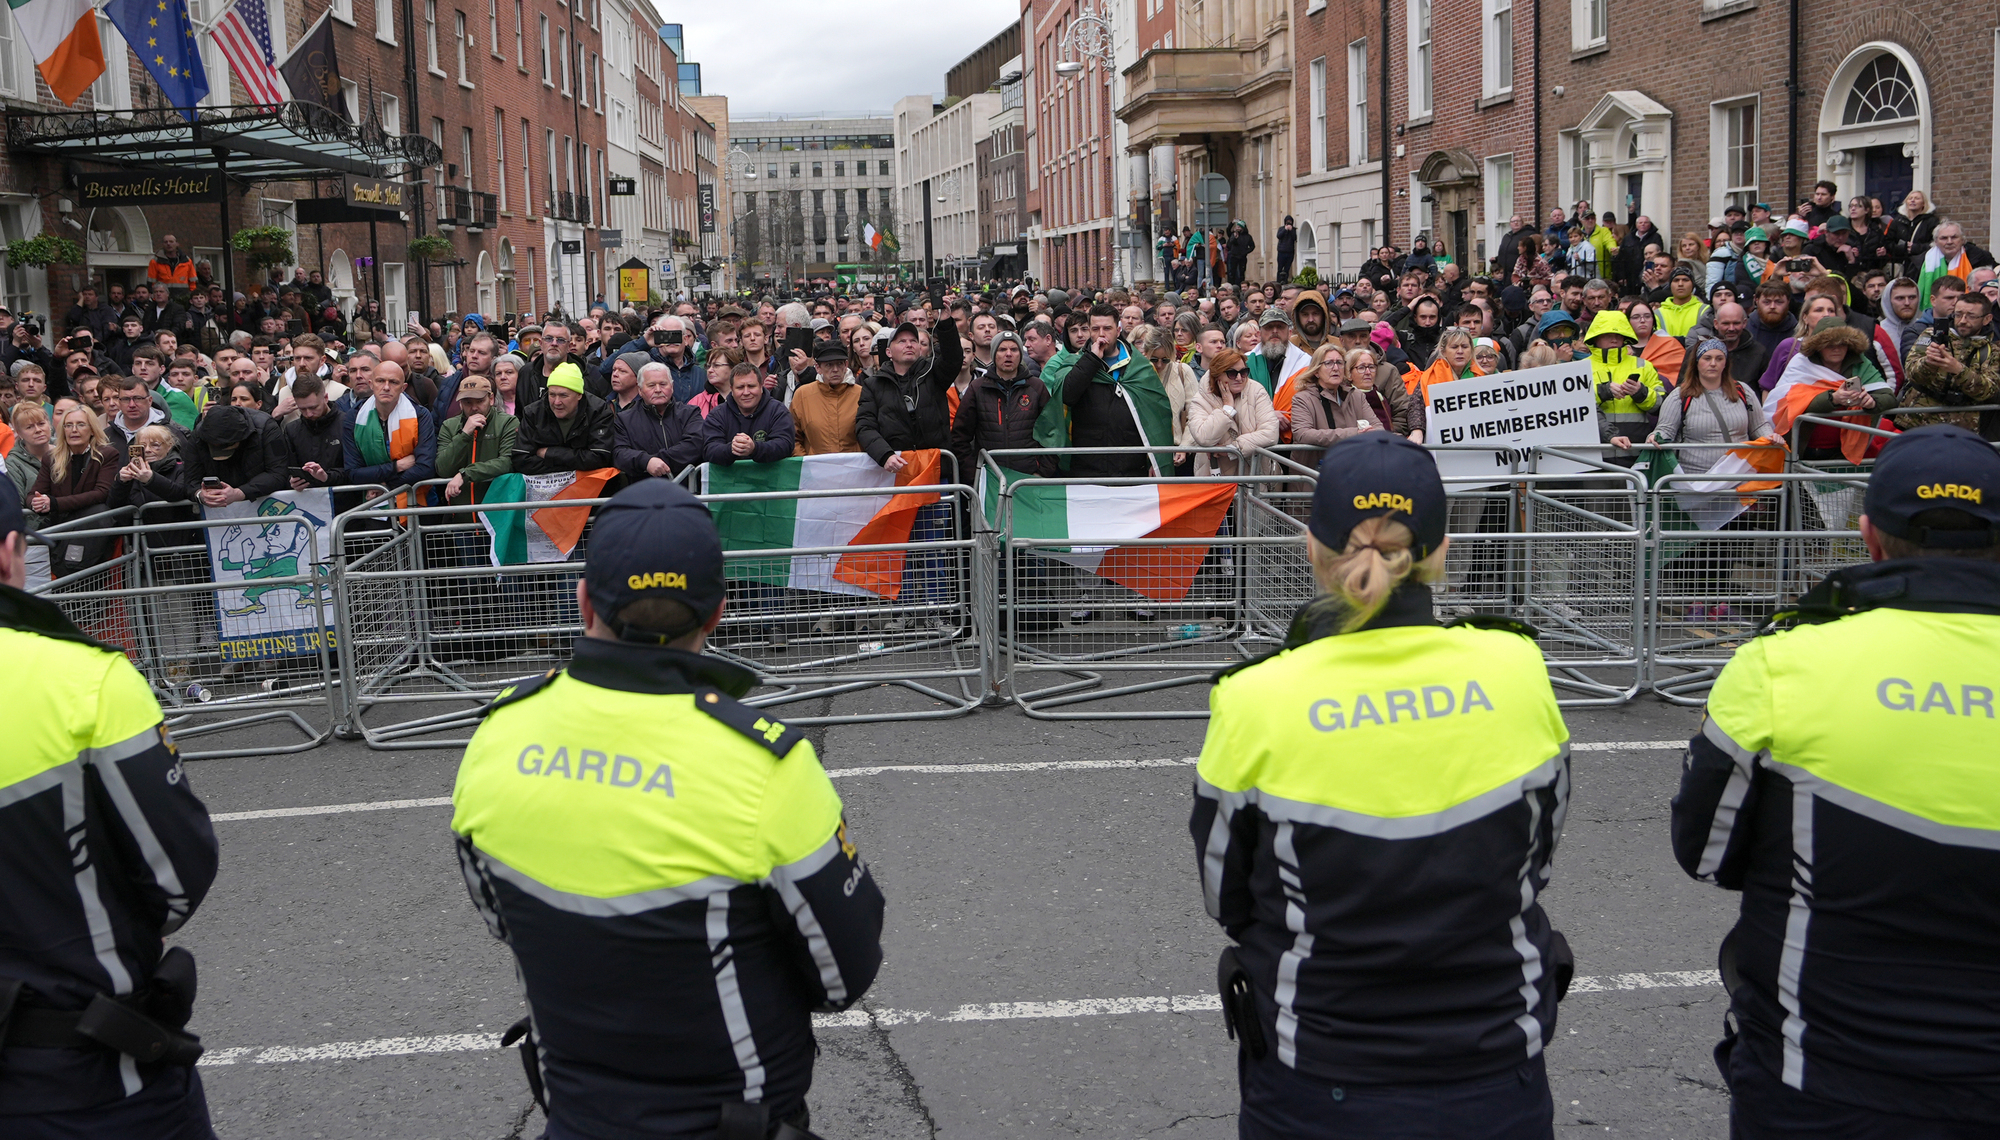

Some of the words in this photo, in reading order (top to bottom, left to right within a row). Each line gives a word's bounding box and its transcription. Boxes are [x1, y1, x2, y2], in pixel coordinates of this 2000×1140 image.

[84, 177, 161, 199] Buswells
[163, 174, 212, 195] Hotel
[1433, 379, 1557, 415] REFERENDUM
[1562, 374, 1589, 393] ON
[1440, 426, 1464, 445] EU
[1470, 405, 1590, 440] MEMBERSHIP
[1495, 446, 1543, 467] NOW
[1353, 493, 1413, 515] GARDA
[1916, 483, 1982, 505] GARDA
[628, 572, 687, 591] GARDA
[220, 635, 298, 660] FIGHTING
[302, 631, 338, 652] IRS
[1309, 680, 1495, 733] GARDA
[1876, 677, 1996, 719] GAR
[516, 743, 676, 799] GARDA
